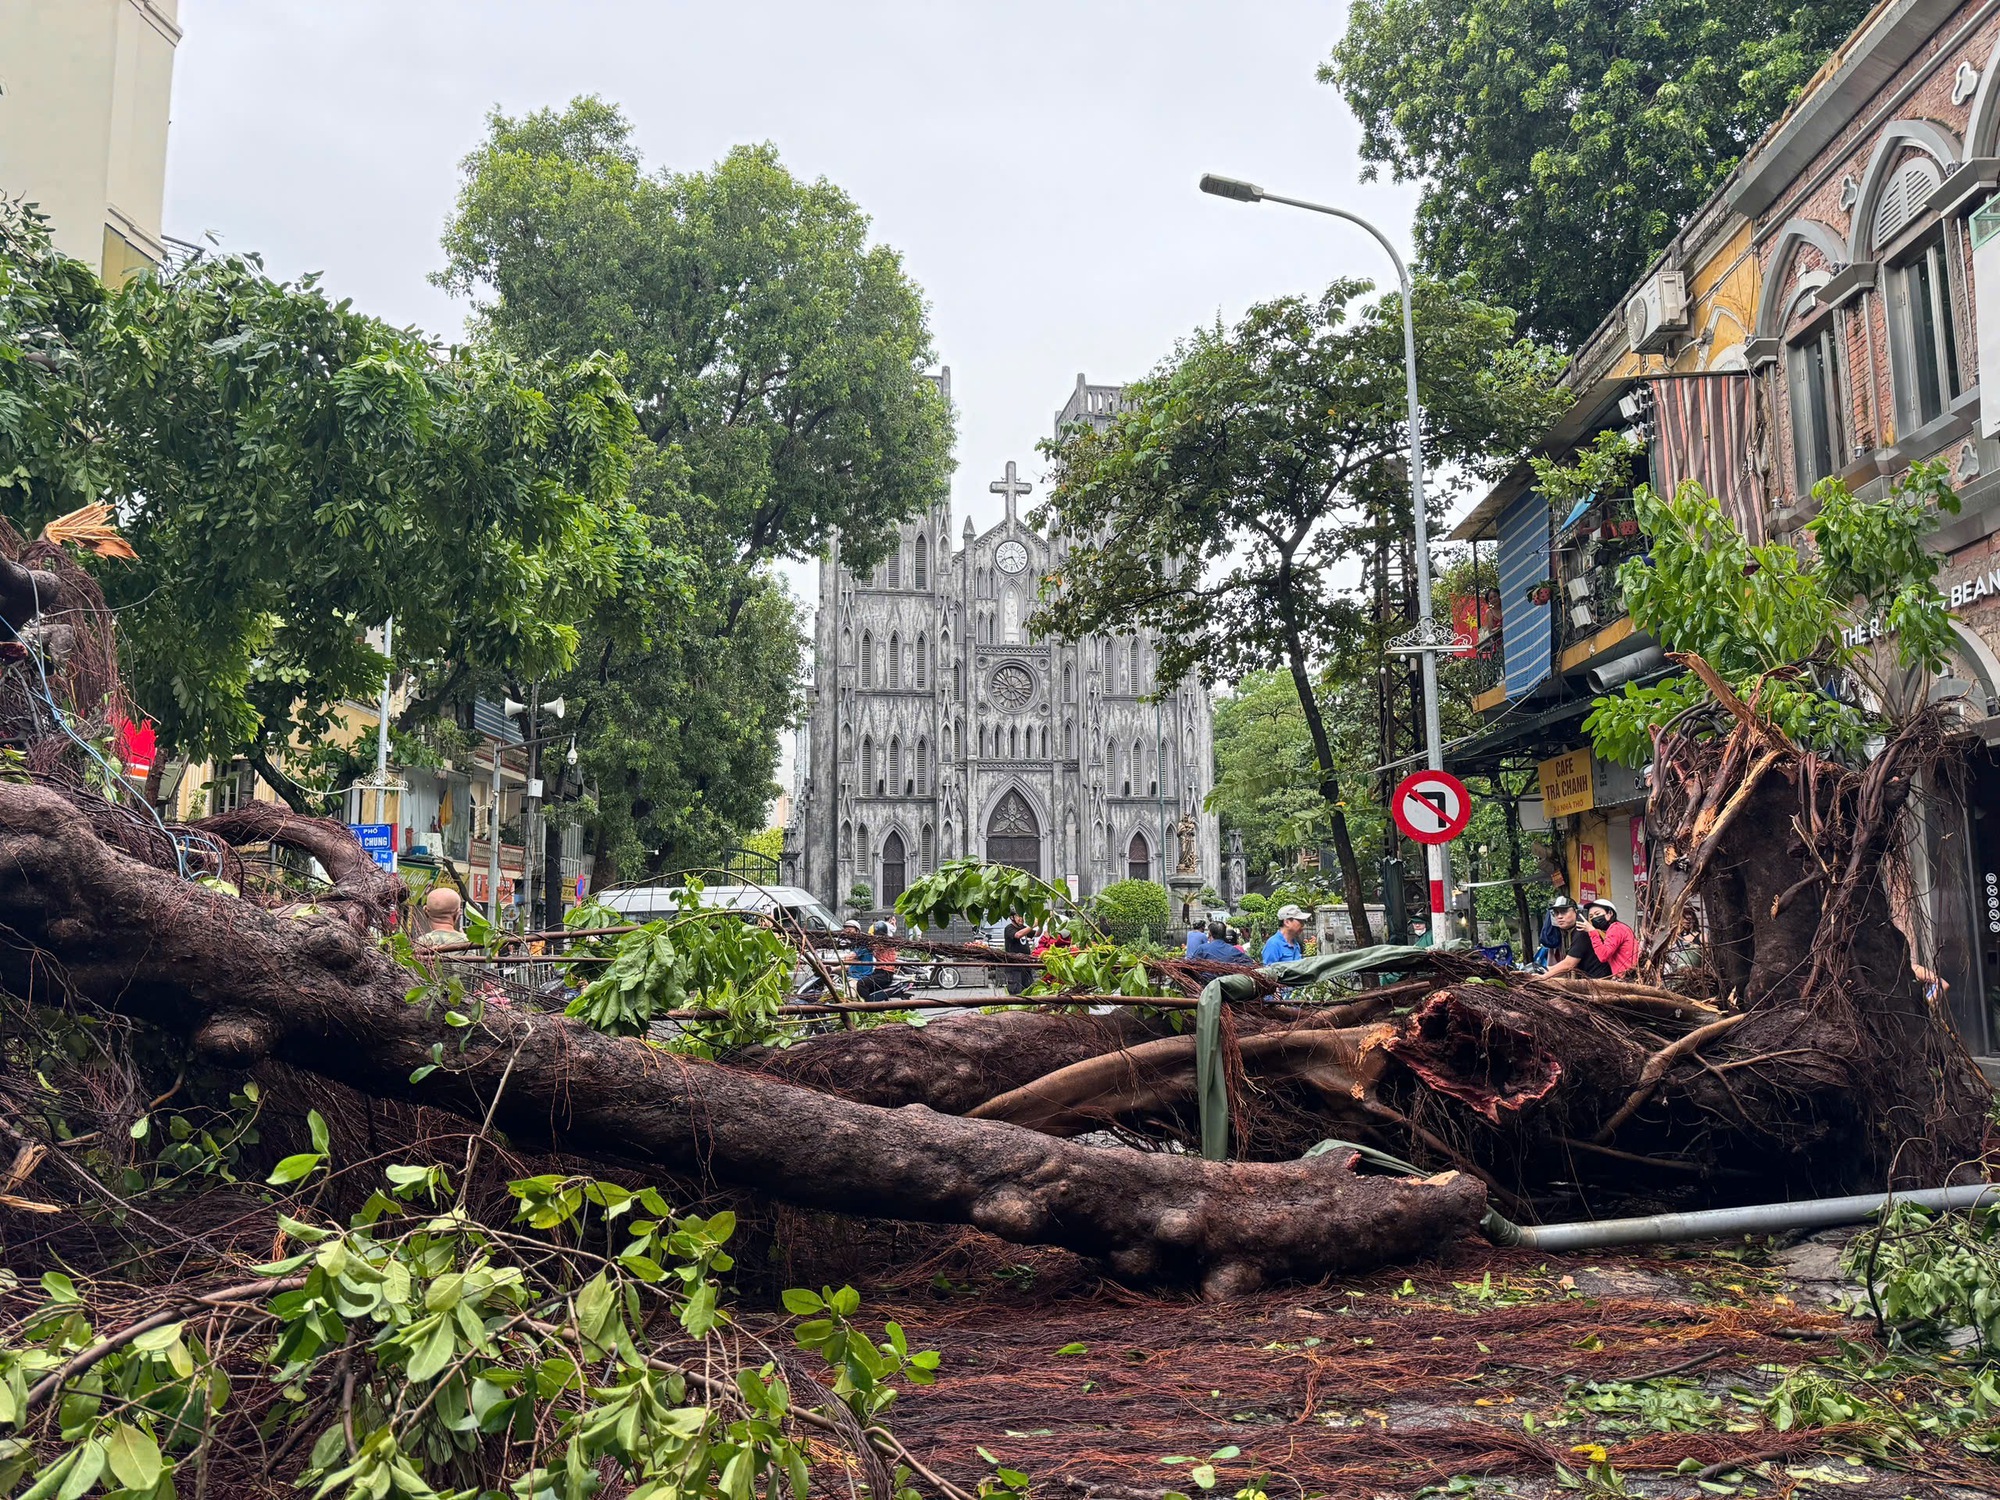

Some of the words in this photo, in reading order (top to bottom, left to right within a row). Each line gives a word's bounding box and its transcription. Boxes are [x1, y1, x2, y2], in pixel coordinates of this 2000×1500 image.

[1841, 624, 1867, 649] THE
[1951, 568, 2000, 608] BEAN
[1555, 757, 1574, 778] CAFE
[1545, 779, 1561, 801] TRÀ
[1561, 774, 1588, 797] CHANH
[1553, 805, 1560, 813] 24
[364, 837, 388, 847] CHUNG
